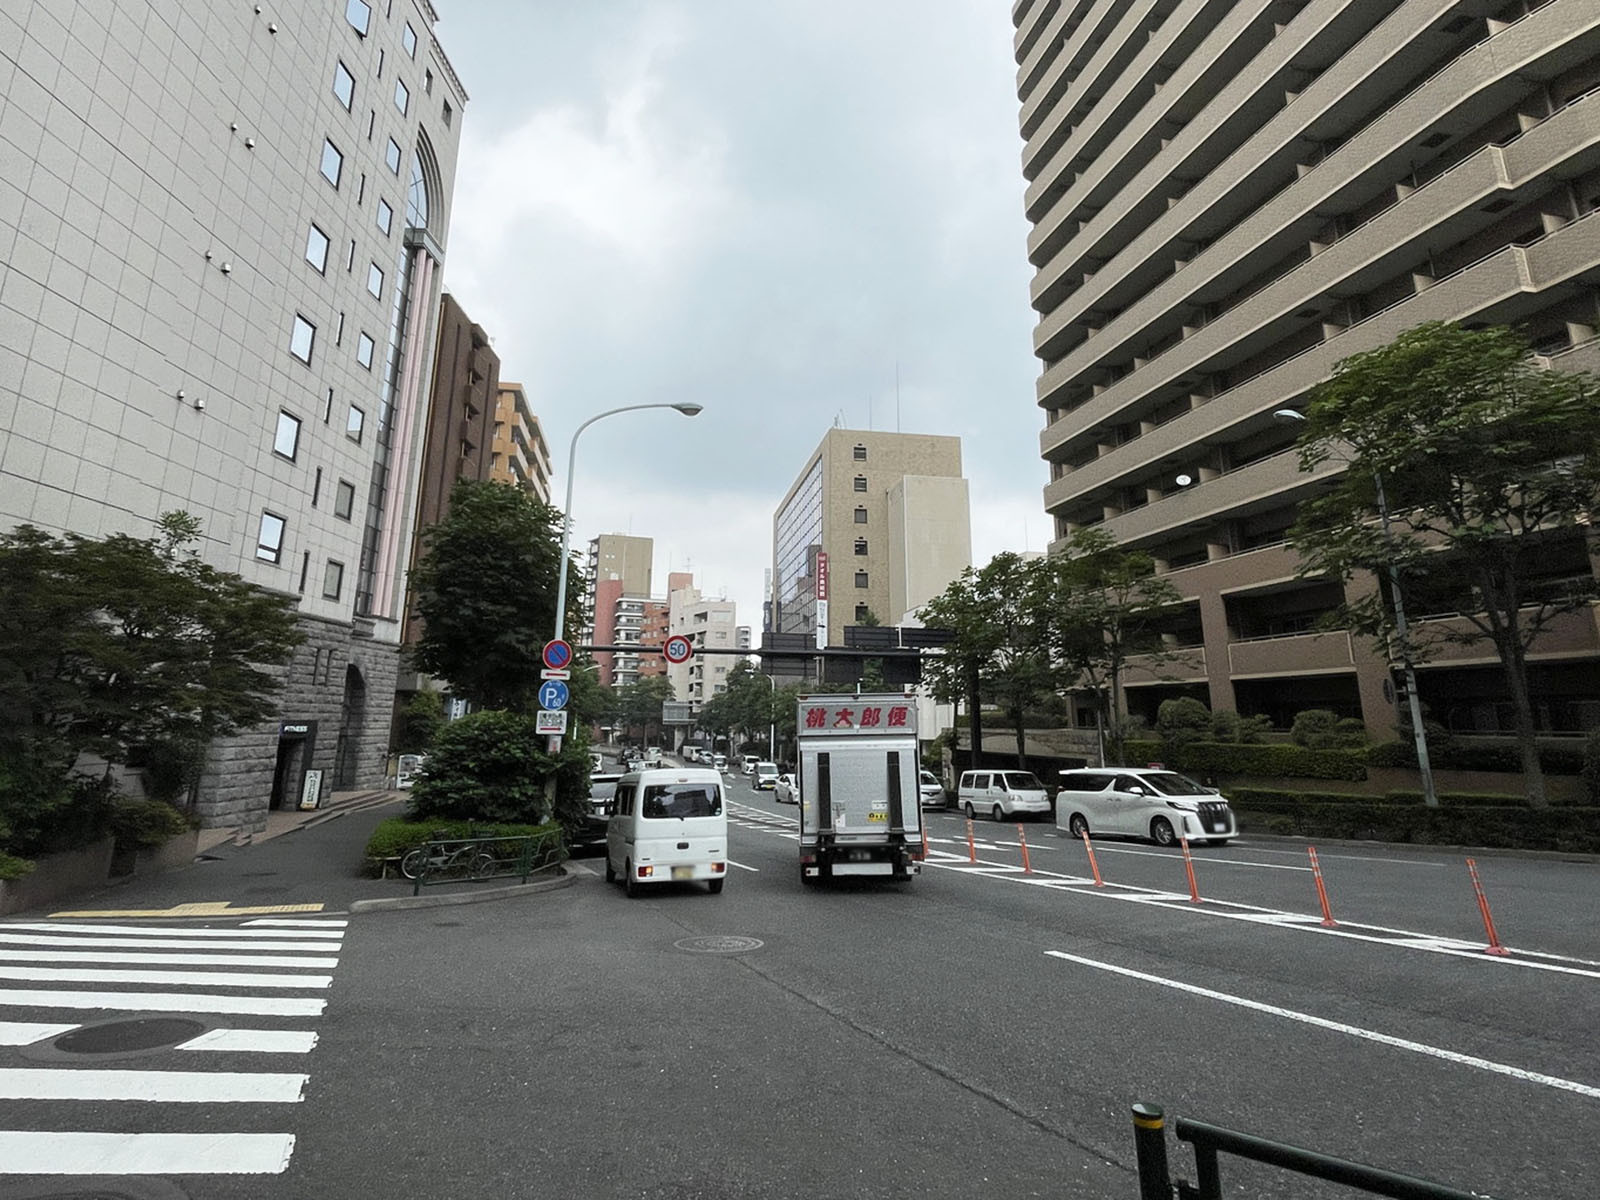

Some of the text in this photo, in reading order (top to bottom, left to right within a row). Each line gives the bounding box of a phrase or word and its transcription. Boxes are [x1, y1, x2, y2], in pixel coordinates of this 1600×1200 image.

[669, 643, 686, 656] 50
[545, 688, 557, 707] P
[805, 706, 908, 728] 桃太郎便
